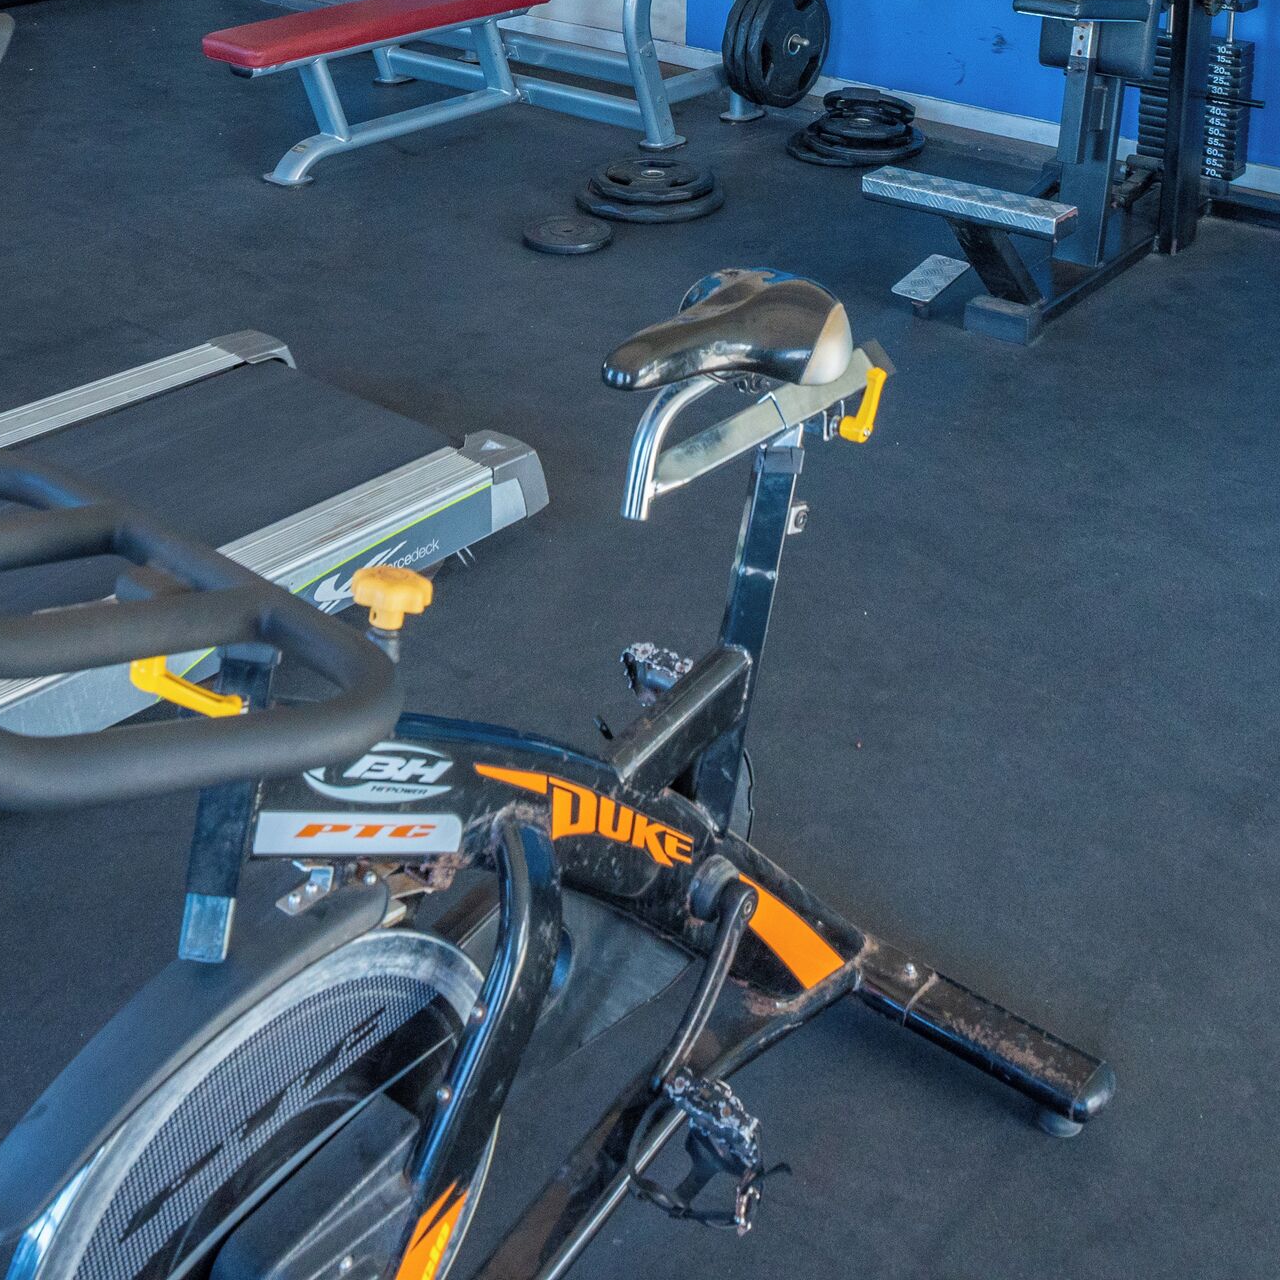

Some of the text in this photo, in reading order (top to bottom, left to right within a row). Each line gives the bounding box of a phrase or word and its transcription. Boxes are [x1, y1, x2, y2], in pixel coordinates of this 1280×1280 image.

[342, 753, 454, 783] BH
[294, 823, 438, 839] PTC
[548, 775, 695, 867] DUKE
